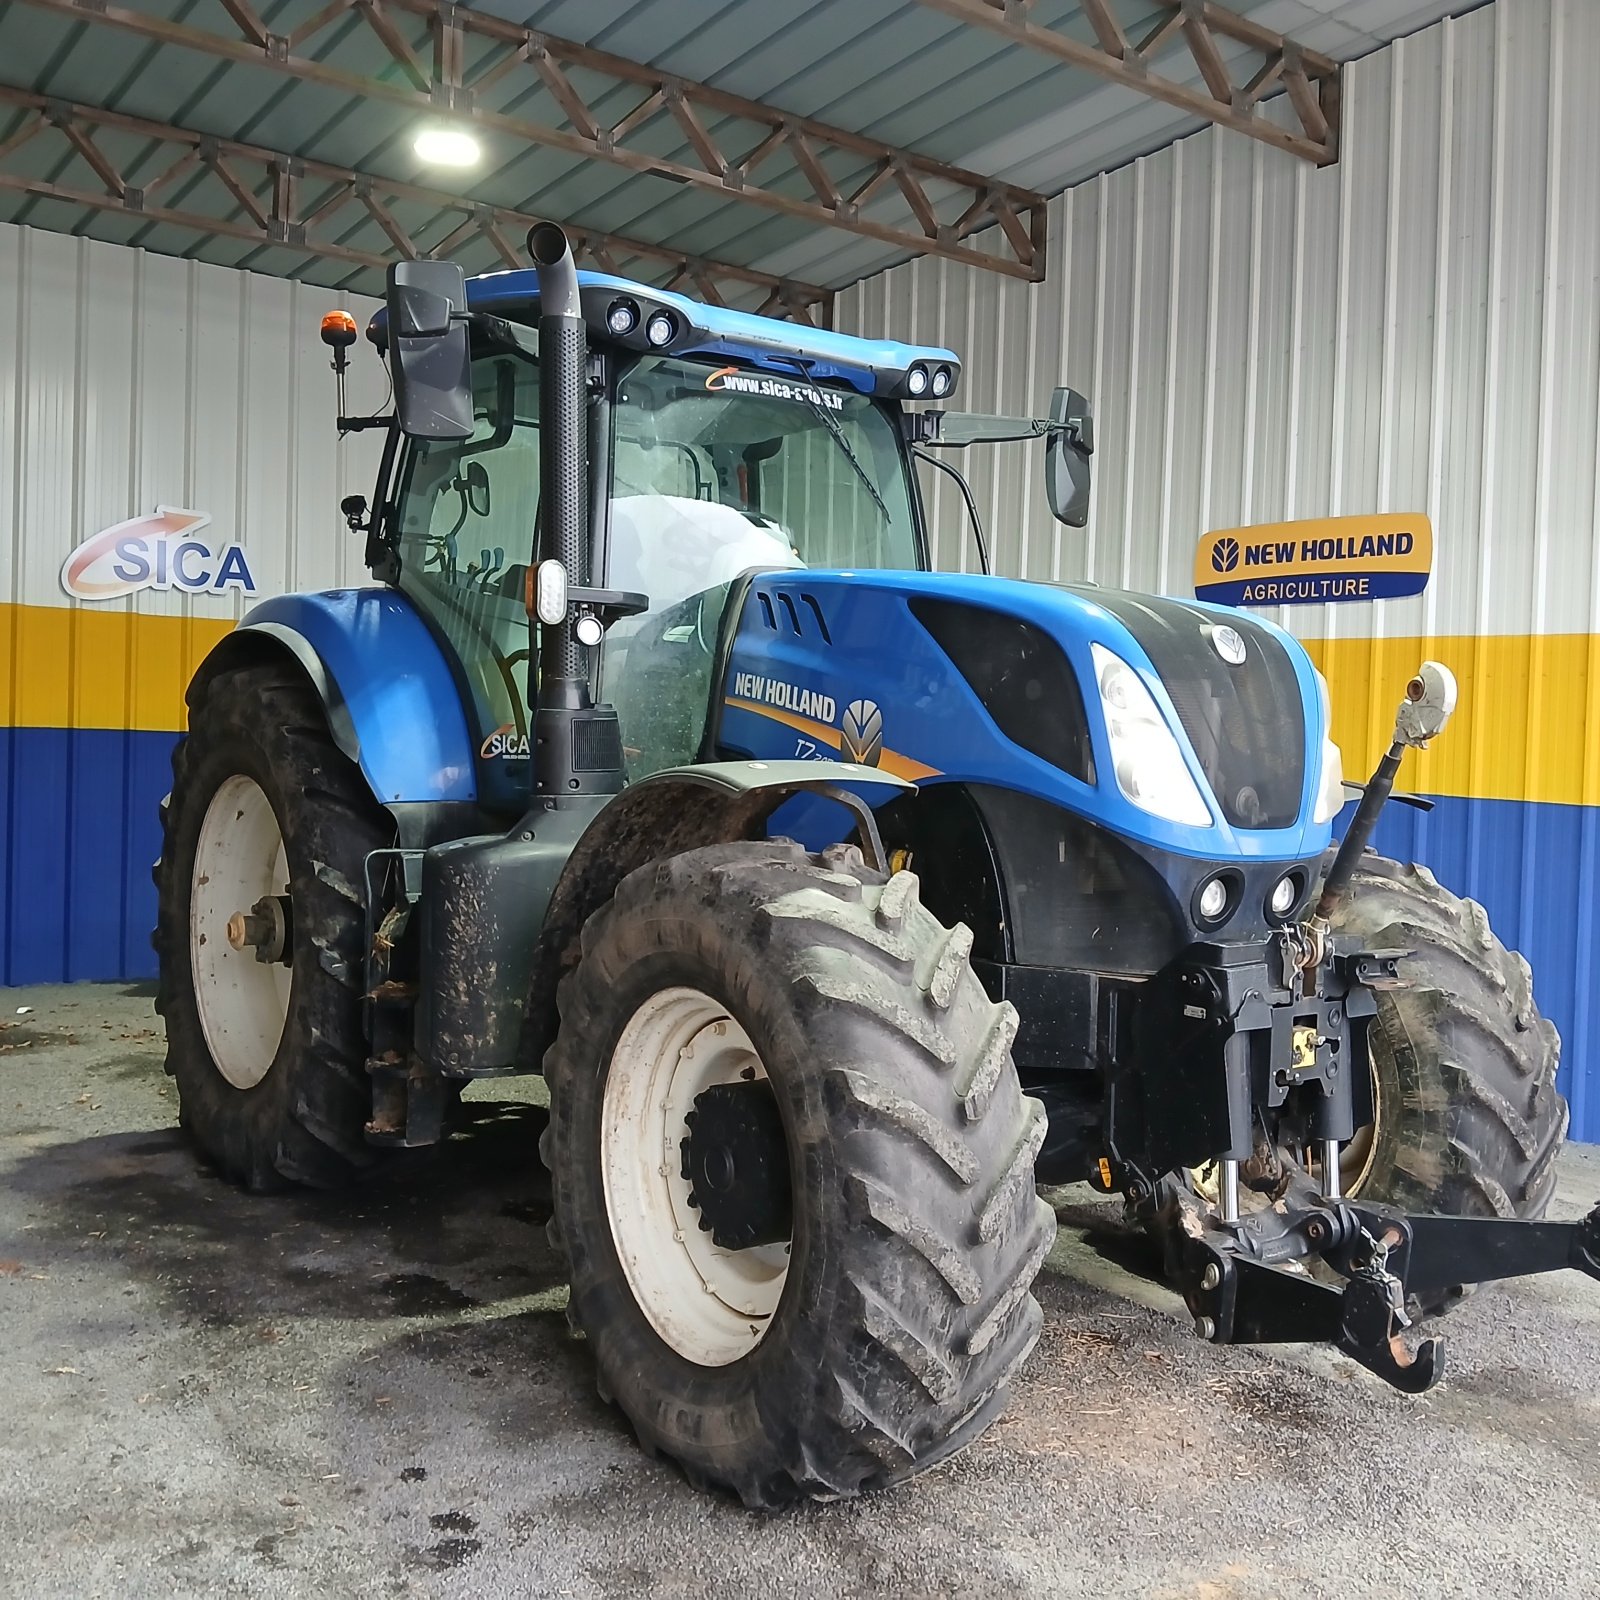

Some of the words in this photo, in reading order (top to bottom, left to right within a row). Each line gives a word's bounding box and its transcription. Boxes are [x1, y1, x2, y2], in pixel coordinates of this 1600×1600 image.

[113, 537, 255, 591] SICA
[1244, 541, 1296, 566] NEW
[1300, 532, 1413, 561] HOLLAND
[1243, 578, 1370, 601] AGRICULTURE
[735, 672, 765, 700] NEW
[765, 678, 836, 723] HOLLAND
[491, 734, 530, 754] SICA
